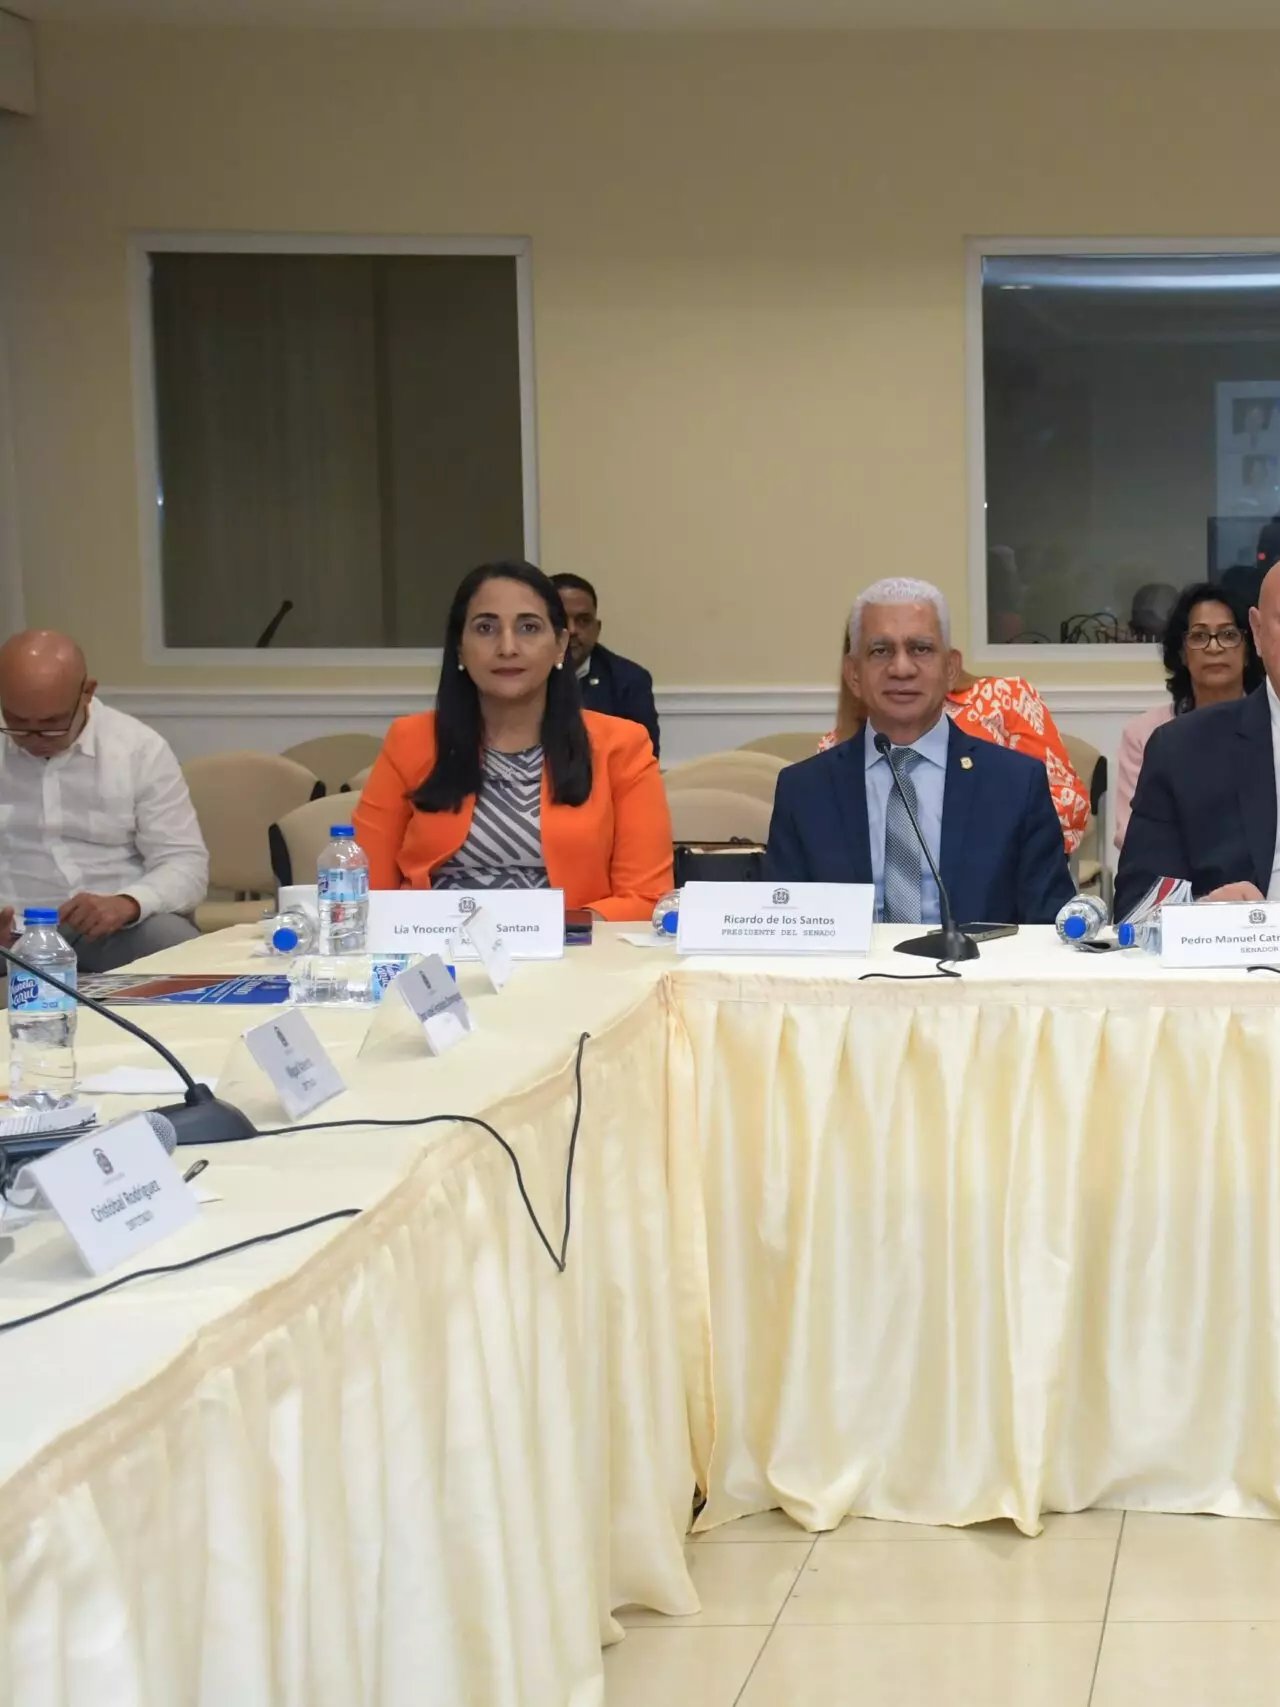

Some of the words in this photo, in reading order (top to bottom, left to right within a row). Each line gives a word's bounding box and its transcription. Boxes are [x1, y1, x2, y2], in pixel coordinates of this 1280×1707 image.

[724, 914, 763, 924] Ricardo
[766, 914, 779, 924] de
[782, 915, 797, 924] los
[800, 915, 835, 925] Santos
[412, 924, 458, 934] Ynocenc
[496, 923, 540, 933] Santana
[721, 928, 776, 936] PRESIDENTE
[803, 929, 836, 937] SENADO
[1181, 935, 1212, 944] Pedro
[1216, 934, 1256, 944] Manuel
[1240, 946, 1279, 954] SENADOR
